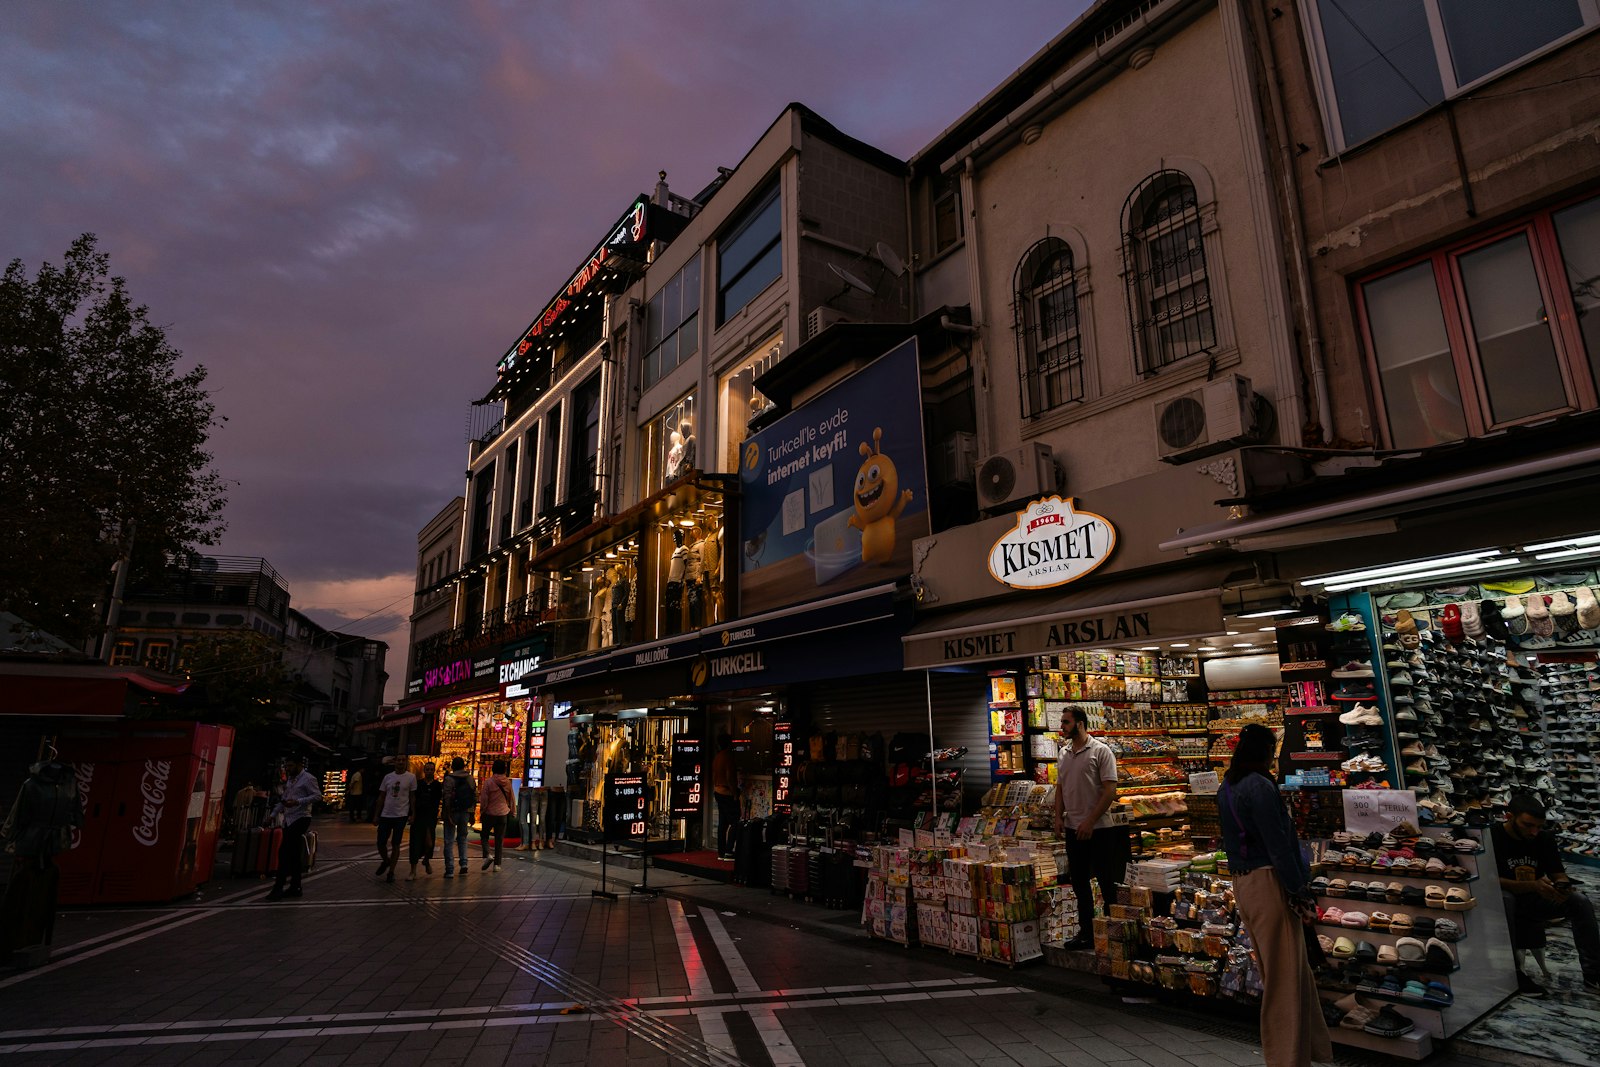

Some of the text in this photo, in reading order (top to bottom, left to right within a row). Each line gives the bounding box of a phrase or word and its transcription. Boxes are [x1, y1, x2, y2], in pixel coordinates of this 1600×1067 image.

[768, 407, 849, 464] Turkcell'le evde
[767, 429, 848, 486] internet keyfi!
[1036, 516, 1055, 526] 1960
[1001, 521, 1096, 577] KISMET
[1027, 563, 1070, 578] ARSLAN
[730, 628, 756, 642] TURKCELL
[943, 612, 1152, 660] KISMET ARSLAN
[499, 656, 540, 684] EXCHANGE
[710, 651, 765, 678] TURKCELL
[1384, 803, 1410, 812] TERLİK
